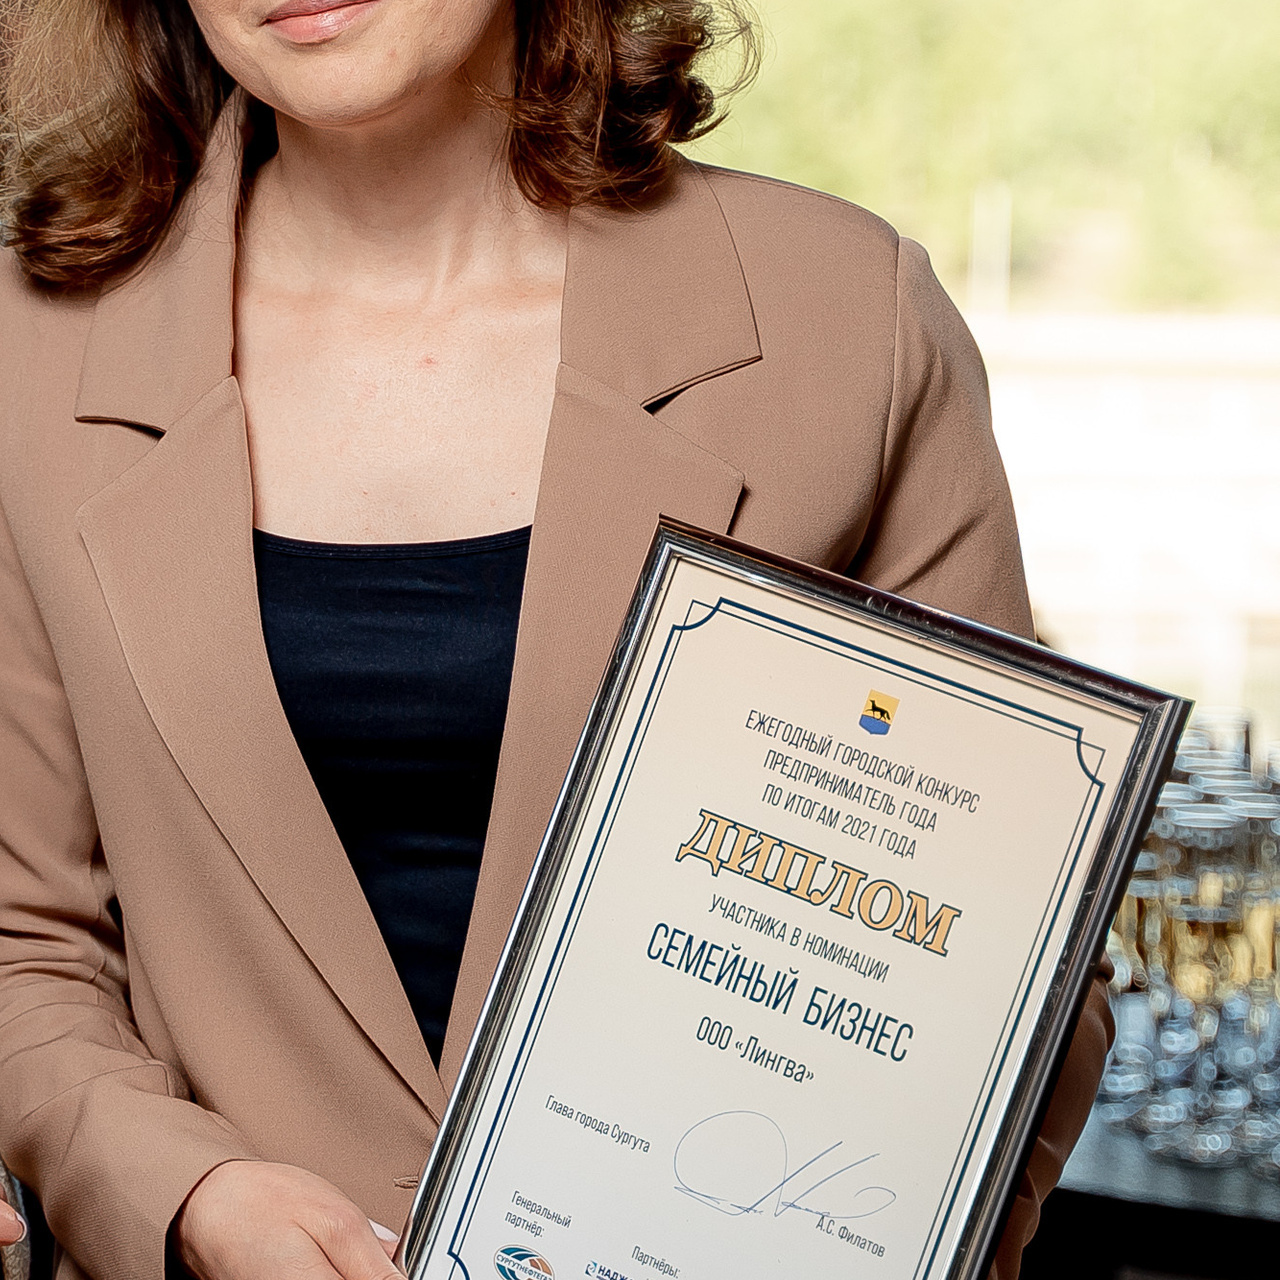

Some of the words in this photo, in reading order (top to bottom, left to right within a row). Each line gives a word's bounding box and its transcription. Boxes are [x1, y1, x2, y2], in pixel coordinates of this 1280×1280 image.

[745, 709, 834, 758] ЕЖЕГОДНЫЙ
[833, 741, 917, 790] ГОРОДСКОЙ
[915, 773, 981, 814] КОНКУРС
[763, 749, 897, 816] ПРЕДПРИНИМАТЕЛЬ
[899, 800, 938, 833] ГОДА
[762, 783, 784, 806] ПО
[784, 790, 842, 830] ИТОГАМ
[841, 814, 878, 844] 2021
[878, 828, 917, 860] ГОДА
[675, 808, 963, 957] ДИПЛОМ
[708, 893, 787, 942] УЧАСТНИКА
[789, 927, 802, 947] В
[803, 932, 891, 984] НОМИНАЦИИ
[646, 922, 800, 1015] СЕМЕЙНЫЙ
[802, 986, 914, 1063] БИЗНЕС
[696, 1016, 734, 1050] ООО
[734, 1035, 815, 1084] «Лингва»
[544, 1094, 576, 1120] Глава
[574, 1108, 611, 1137] города
[610, 1119, 652, 1154] Сургута
[504, 1211, 545, 1238] партнёр:
[511, 1190, 572, 1229] Генеральный
[815, 1215, 835, 1237] А.С.
[837, 1225, 886, 1259] Филатов
[631, 1245, 681, 1279] Партнёры:
